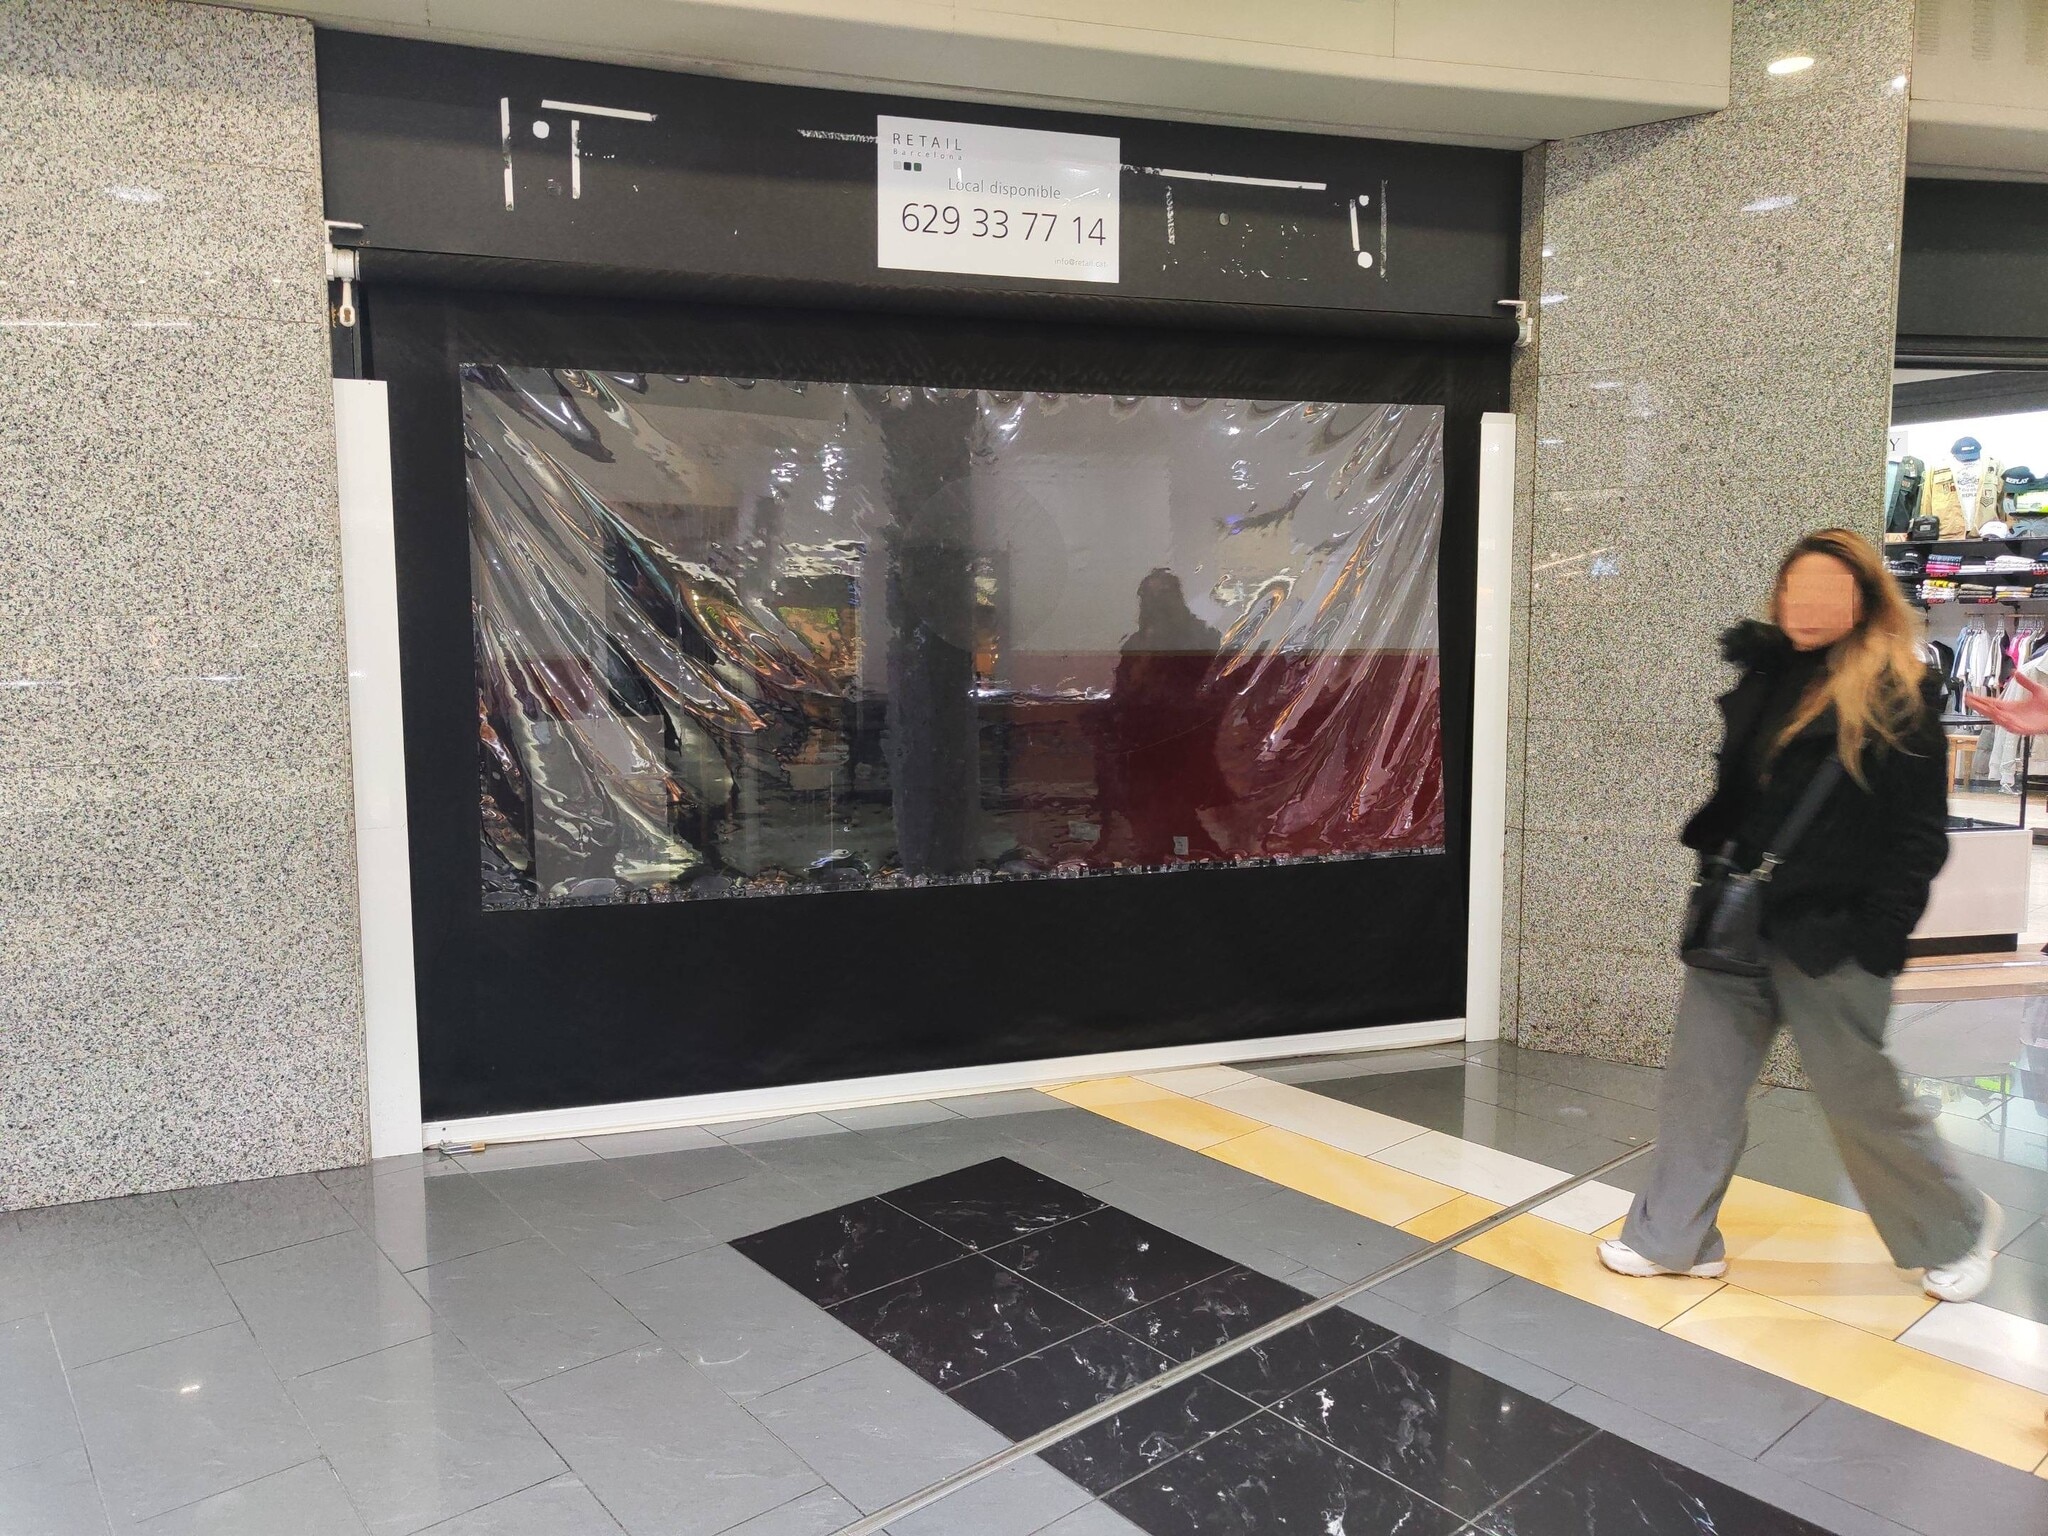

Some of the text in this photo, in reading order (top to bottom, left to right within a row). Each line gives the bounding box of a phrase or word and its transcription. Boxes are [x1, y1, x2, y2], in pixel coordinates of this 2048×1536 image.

[892, 133, 962, 151] RETAIL
[893, 148, 962, 161] Barcelona
[948, 178, 1061, 199] Local disponible
[901, 202, 1106, 246] 629 33 77 14
